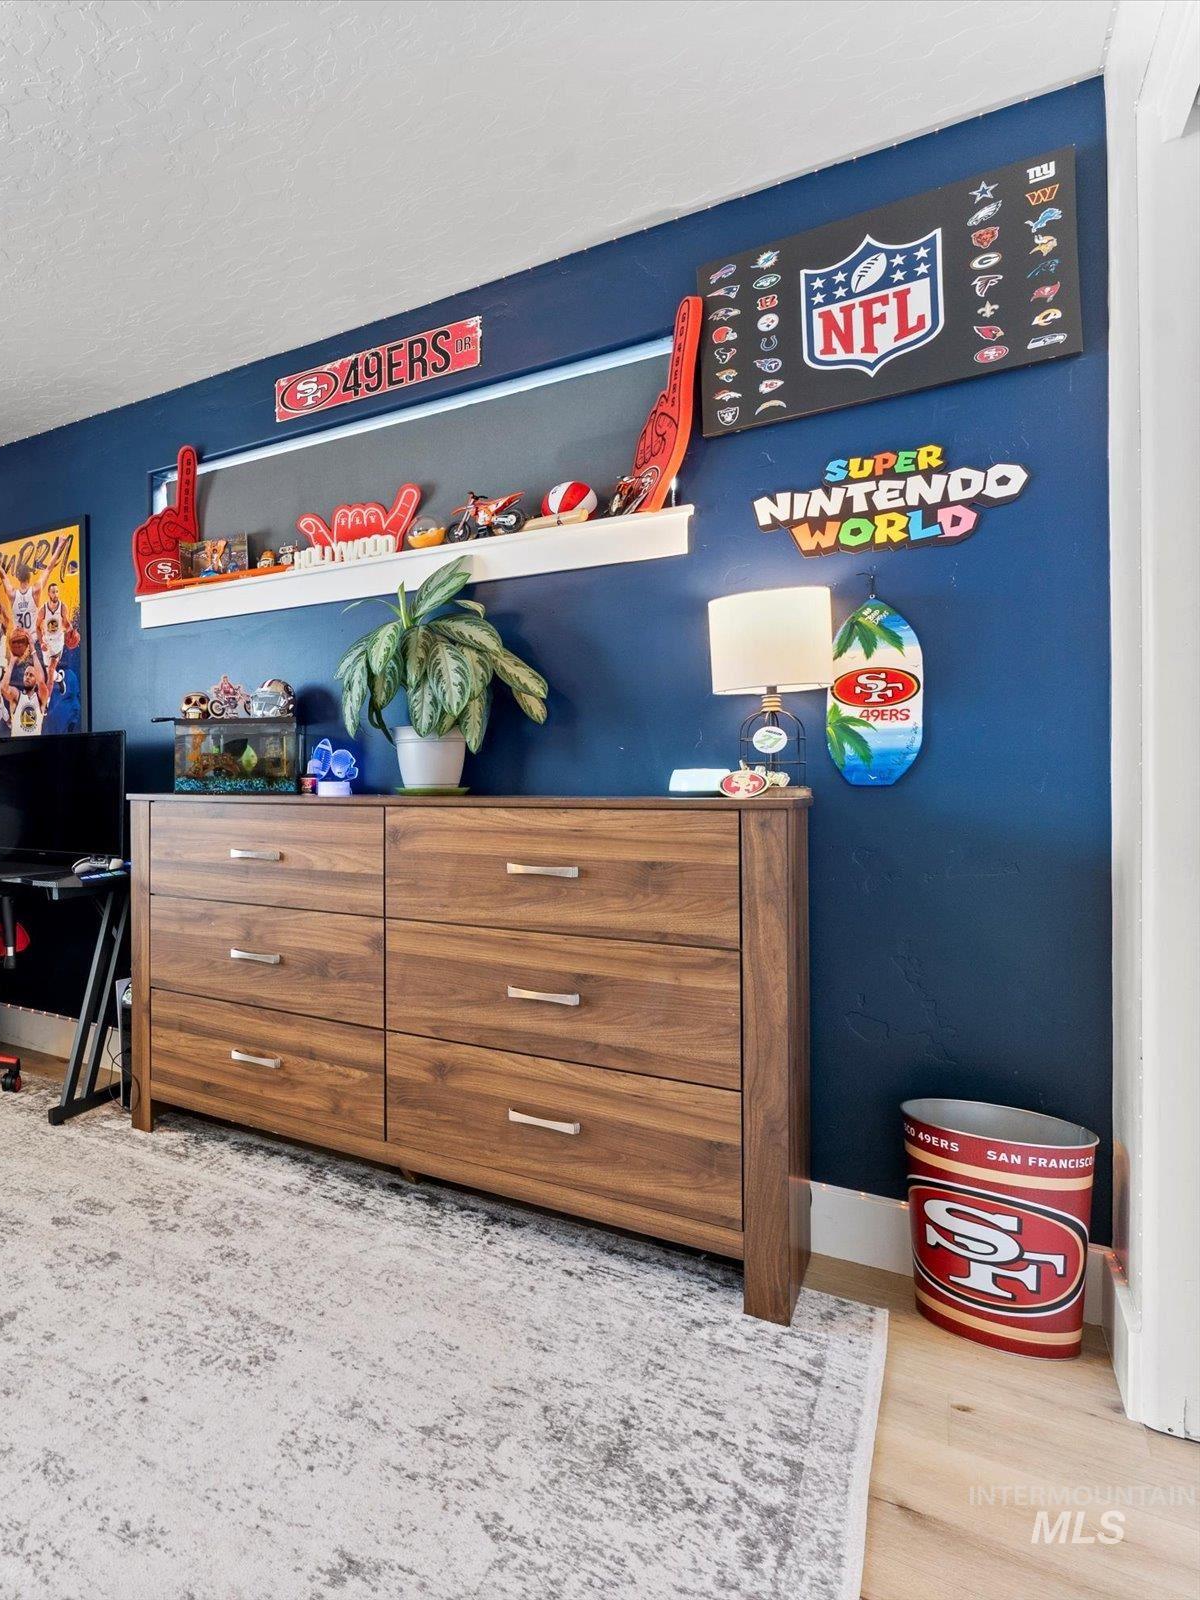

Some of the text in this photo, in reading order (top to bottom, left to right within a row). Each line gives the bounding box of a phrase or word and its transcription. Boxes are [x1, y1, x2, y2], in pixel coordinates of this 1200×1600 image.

[818, 288, 926, 356] NFL
[342, 330, 451, 397] 49ERS
[455, 337, 475, 353] DR.
[824, 445, 945, 482] SUPER
[753, 463, 1029, 526] NINTENDO
[792, 504, 978, 551] WORLD
[294, 534, 396, 570] HOLLYWOOD
[16, 611, 32, 630] 30
[853, 672, 903, 703] SF
[859, 708, 911, 722] 49ERS
[918, 1132, 960, 1152] 49ERS
[986, 1150, 1022, 1164] SAN
[924, 1199, 1065, 1299] SF
